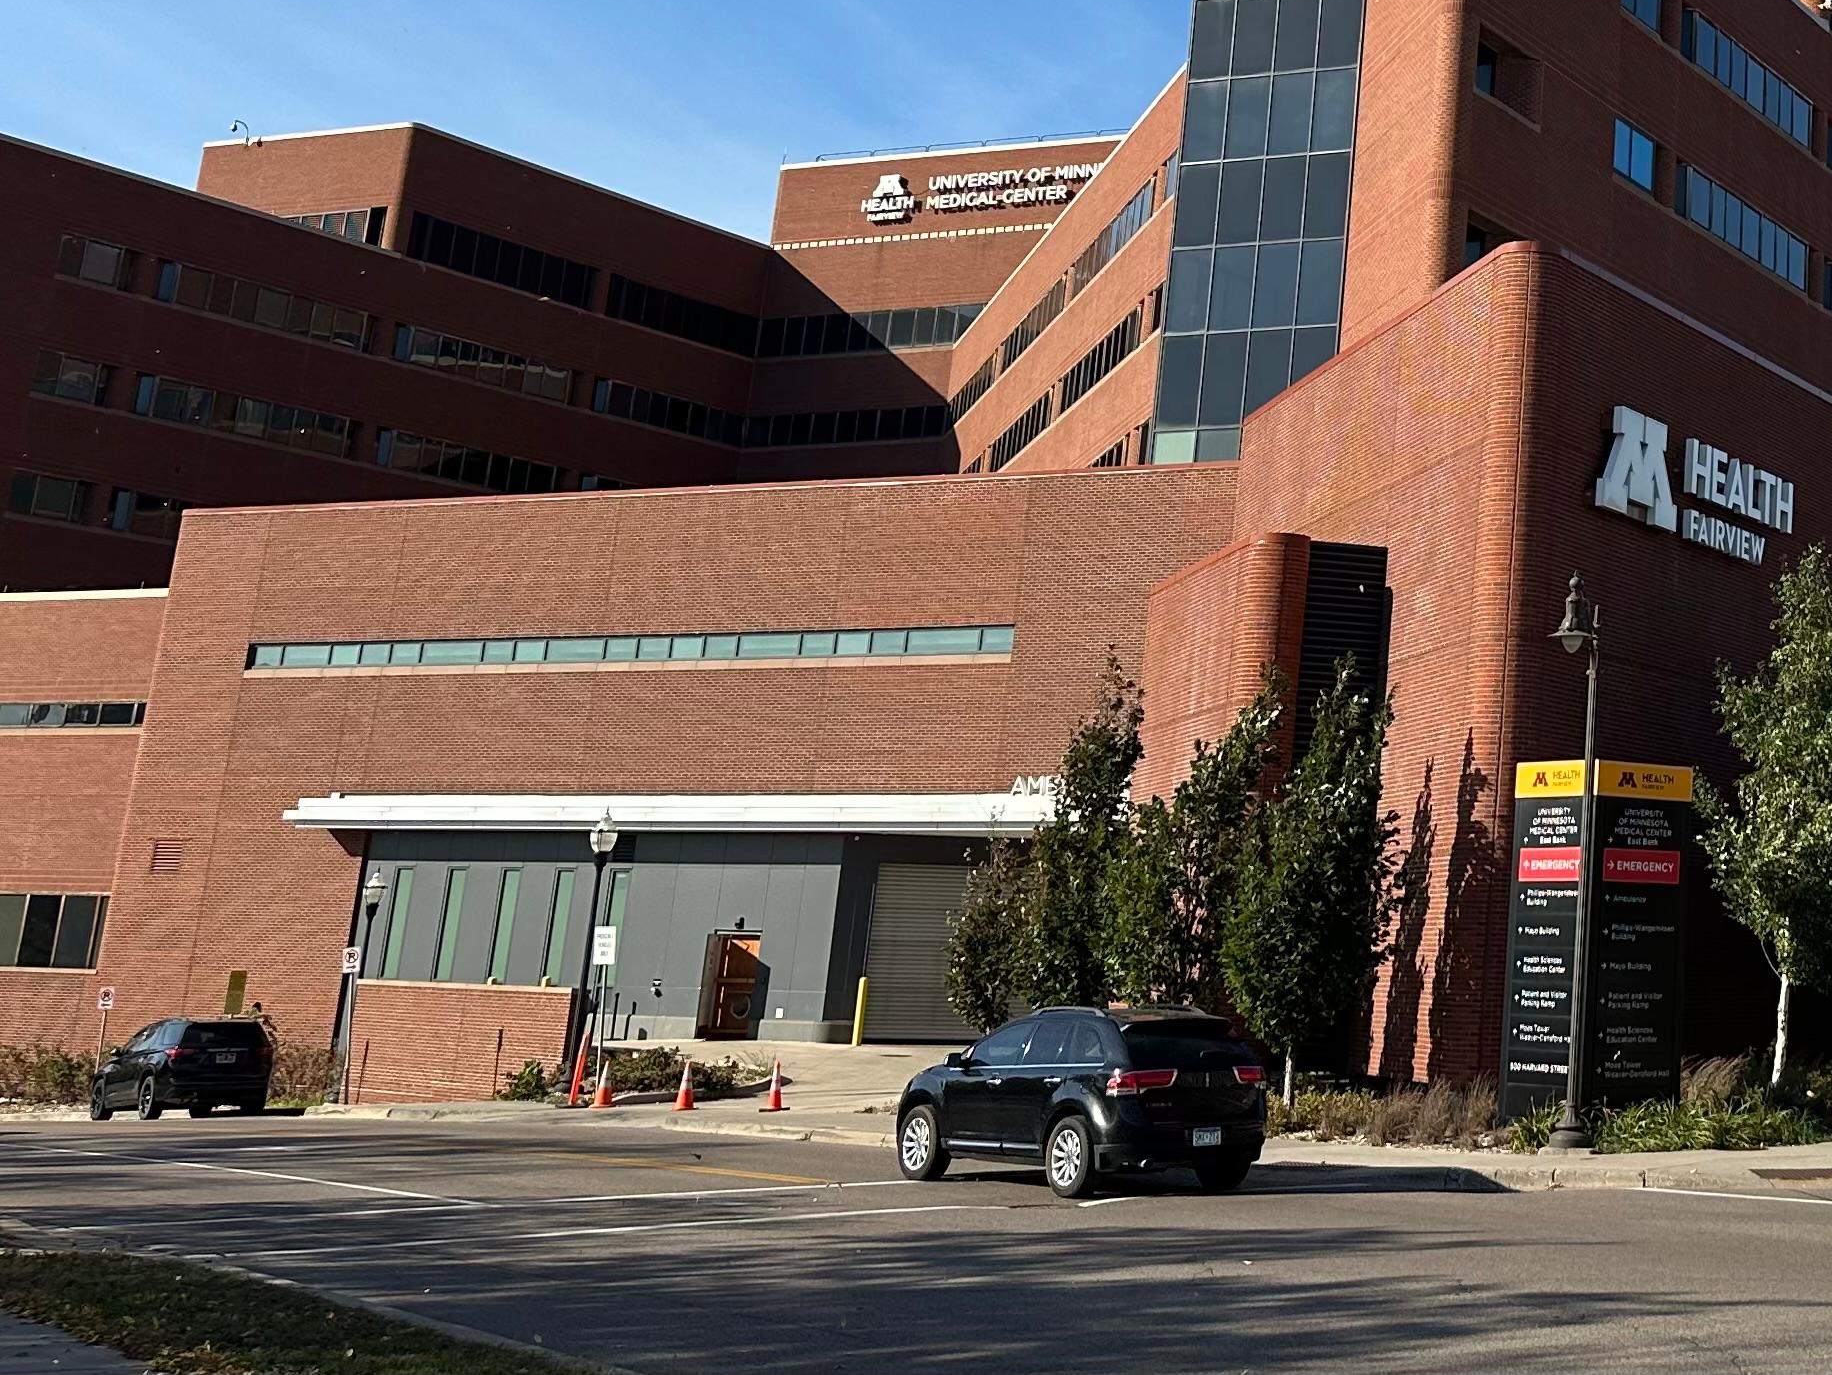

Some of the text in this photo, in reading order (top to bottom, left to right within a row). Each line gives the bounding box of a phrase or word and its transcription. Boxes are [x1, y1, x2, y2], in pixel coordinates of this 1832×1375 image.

[928, 169, 1024, 191] UNIVERSITY
[1028, 167, 1052, 183] OF
[926, 185, 1068, 210] MEDICAL CENTER
[861, 196, 915, 213] HEALTH
[1683, 437, 1794, 534] HEALTH
[1682, 508, 1766, 566] FAIRVIEW
[1552, 769, 1581, 779] HEALTH
[1642, 773, 1674, 785] HEALTH
[1537, 807, 1571, 816] UNIVERSITY
[1624, 808, 1664, 818] UNIVERSITY
[1532, 816, 1576, 825] OF MINNESOTA
[1630, 818, 1669, 827] MINNESOTA
[1529, 825, 1578, 835] MEDICAL CENTER
[1614, 827, 1673, 837] MEDICAL CENTER
[1531, 859, 1580, 870] EMERGENCY
[1616, 860, 1675, 873] EMERGENCY
[1539, 926, 1560, 936] Building
[1548, 965, 1566, 974] Center
[1627, 962, 1652, 972] Building
[1521, 989, 1539, 998] Patient
[1540, 990, 1549, 998] and
[1608, 991, 1629, 1000] Patient
[1631, 992, 1642, 1000] and
[1520, 998, 1556, 1009] Parking Ramp
[1607, 1000, 1631, 1010] Parking
[1521, 1063, 1549, 1073] HARVARD
